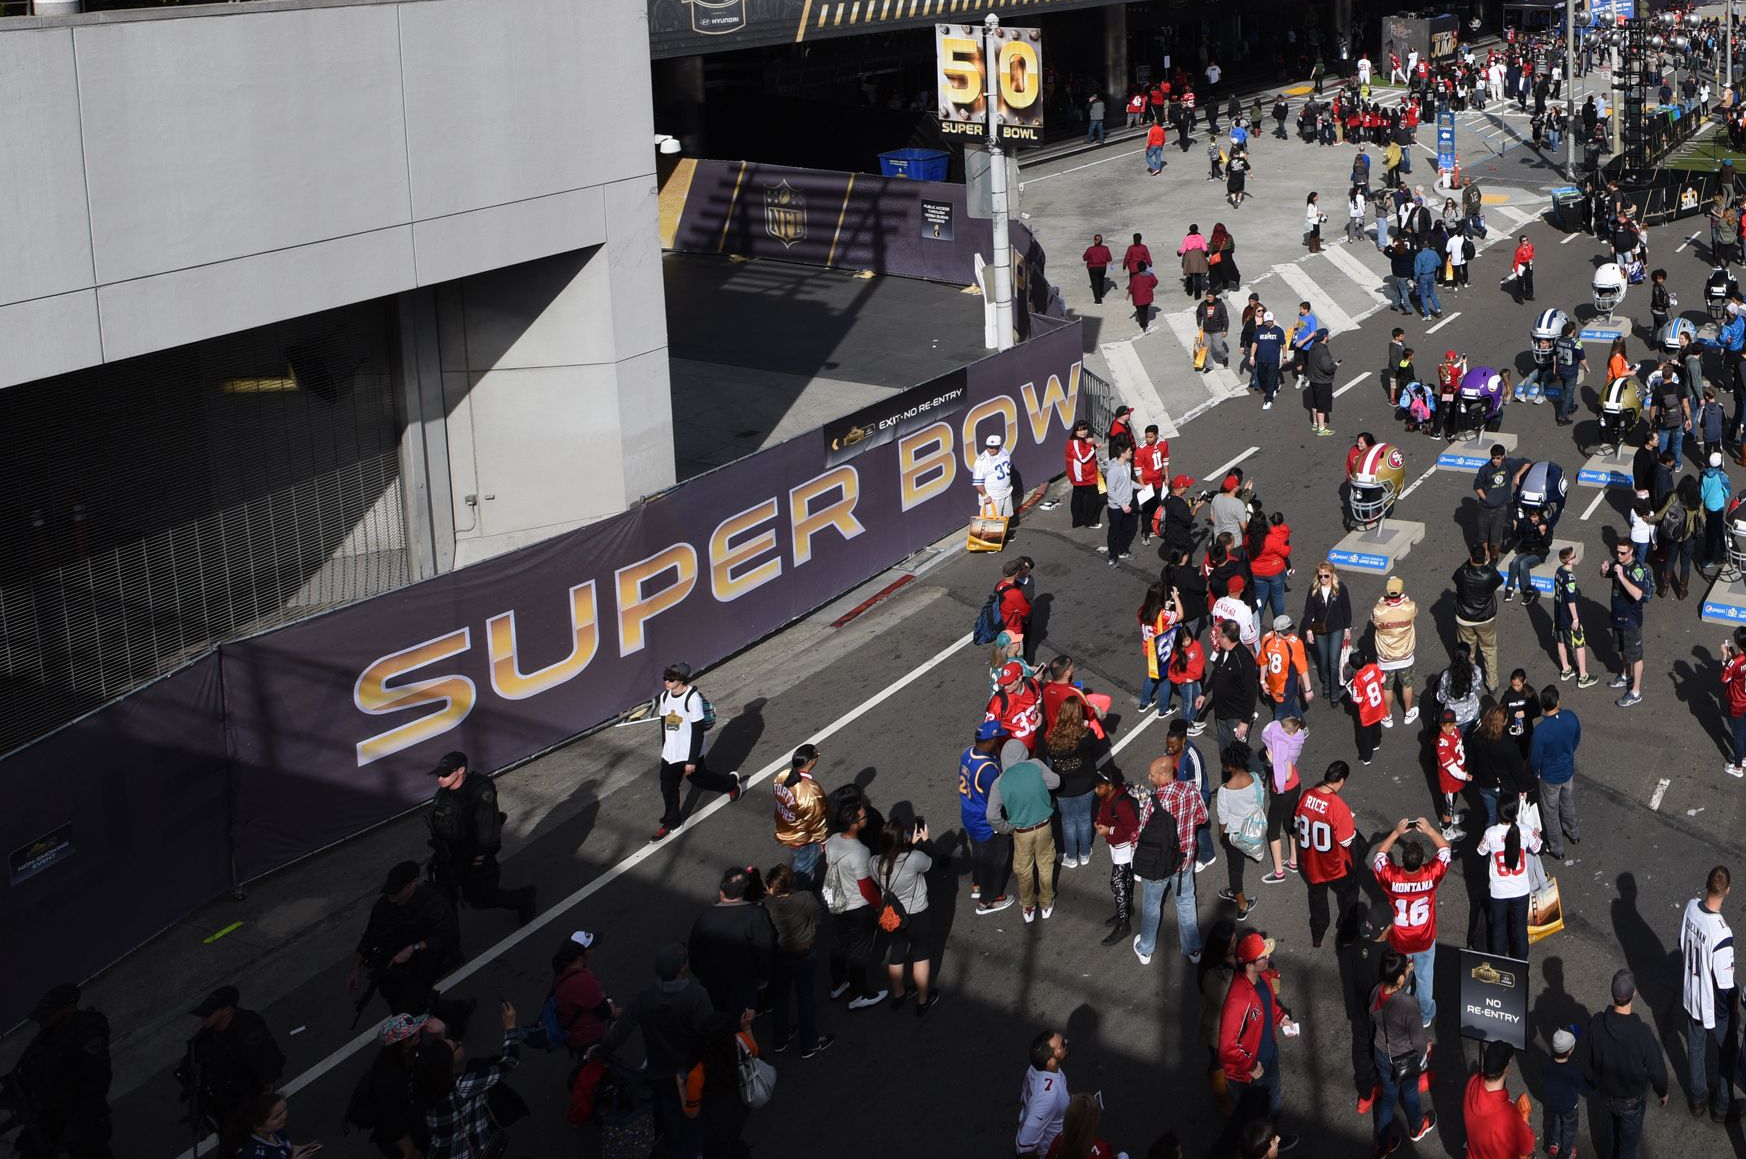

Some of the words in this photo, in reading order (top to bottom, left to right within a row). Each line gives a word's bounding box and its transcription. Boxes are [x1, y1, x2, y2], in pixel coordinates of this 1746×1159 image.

[711, 17, 740, 25] HYUNDAI
[1431, 31, 1454, 43] VERTICAL
[1431, 38, 1458, 59] JUMP
[941, 122, 983, 136] SUPER
[1003, 127, 1038, 140] BOWL
[768, 208, 804, 239] NFL
[1556, 347, 1573, 366] 29
[918, 387, 963, 413] RE-ENTRY
[1152, 451, 1163, 471] 11
[353, 463, 867, 768] SUPER
[1366, 681, 1382, 708] 8
[1304, 794, 1329, 815] RICE
[1390, 878, 1434, 894] MONTANA
[1394, 896, 1430, 928] 16
[1485, 997, 1502, 1009] NO
[1466, 1005, 1520, 1025] RE-ENTRY
[1044, 1078, 1053, 1092] 7
